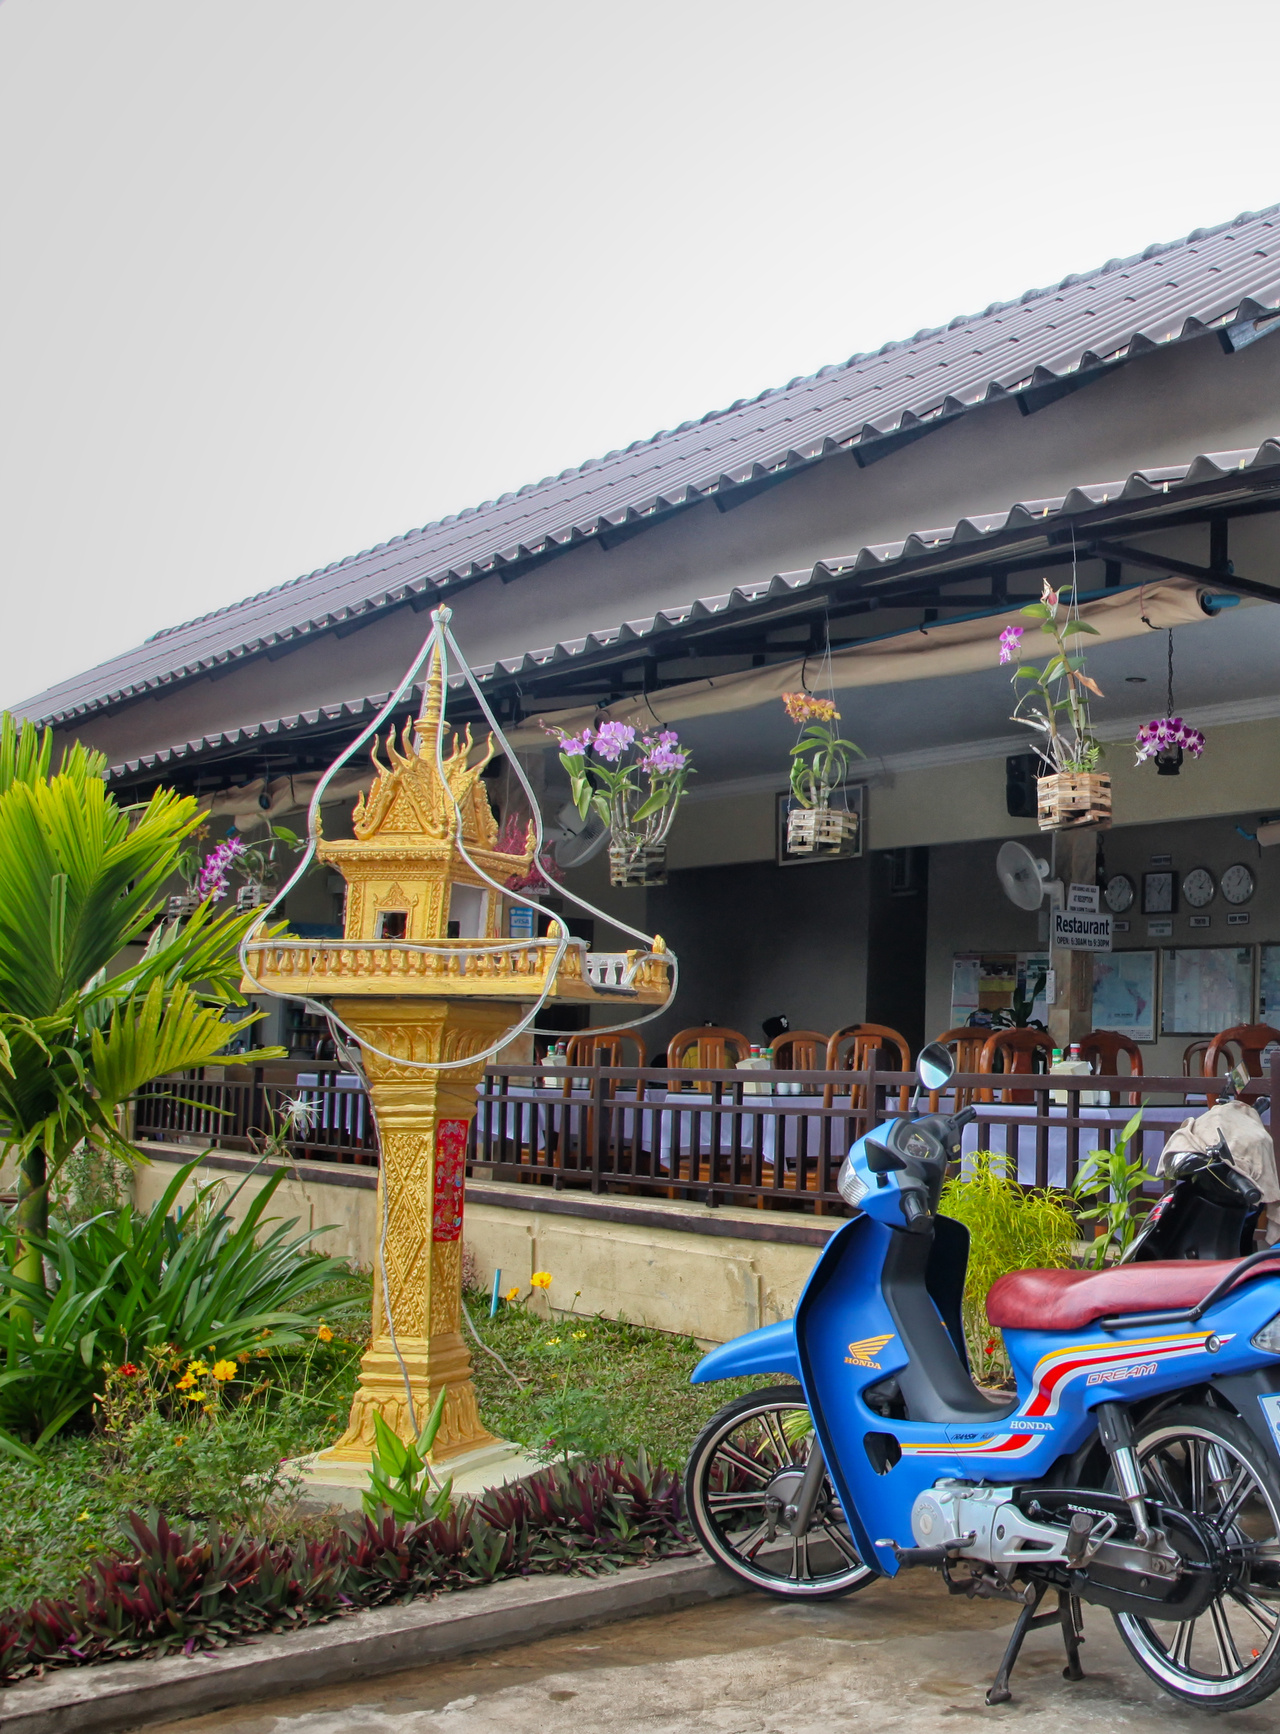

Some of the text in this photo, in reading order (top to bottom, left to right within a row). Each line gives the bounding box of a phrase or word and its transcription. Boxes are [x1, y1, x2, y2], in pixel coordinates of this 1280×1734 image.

[1056, 915, 1110, 935] Restaurant
[844, 1357, 882, 1370] HONDA
[1086, 1362, 1158, 1386] DREAM
[1009, 1421, 1055, 1430] HONDA
[1067, 1503, 1117, 1519] HONDA
